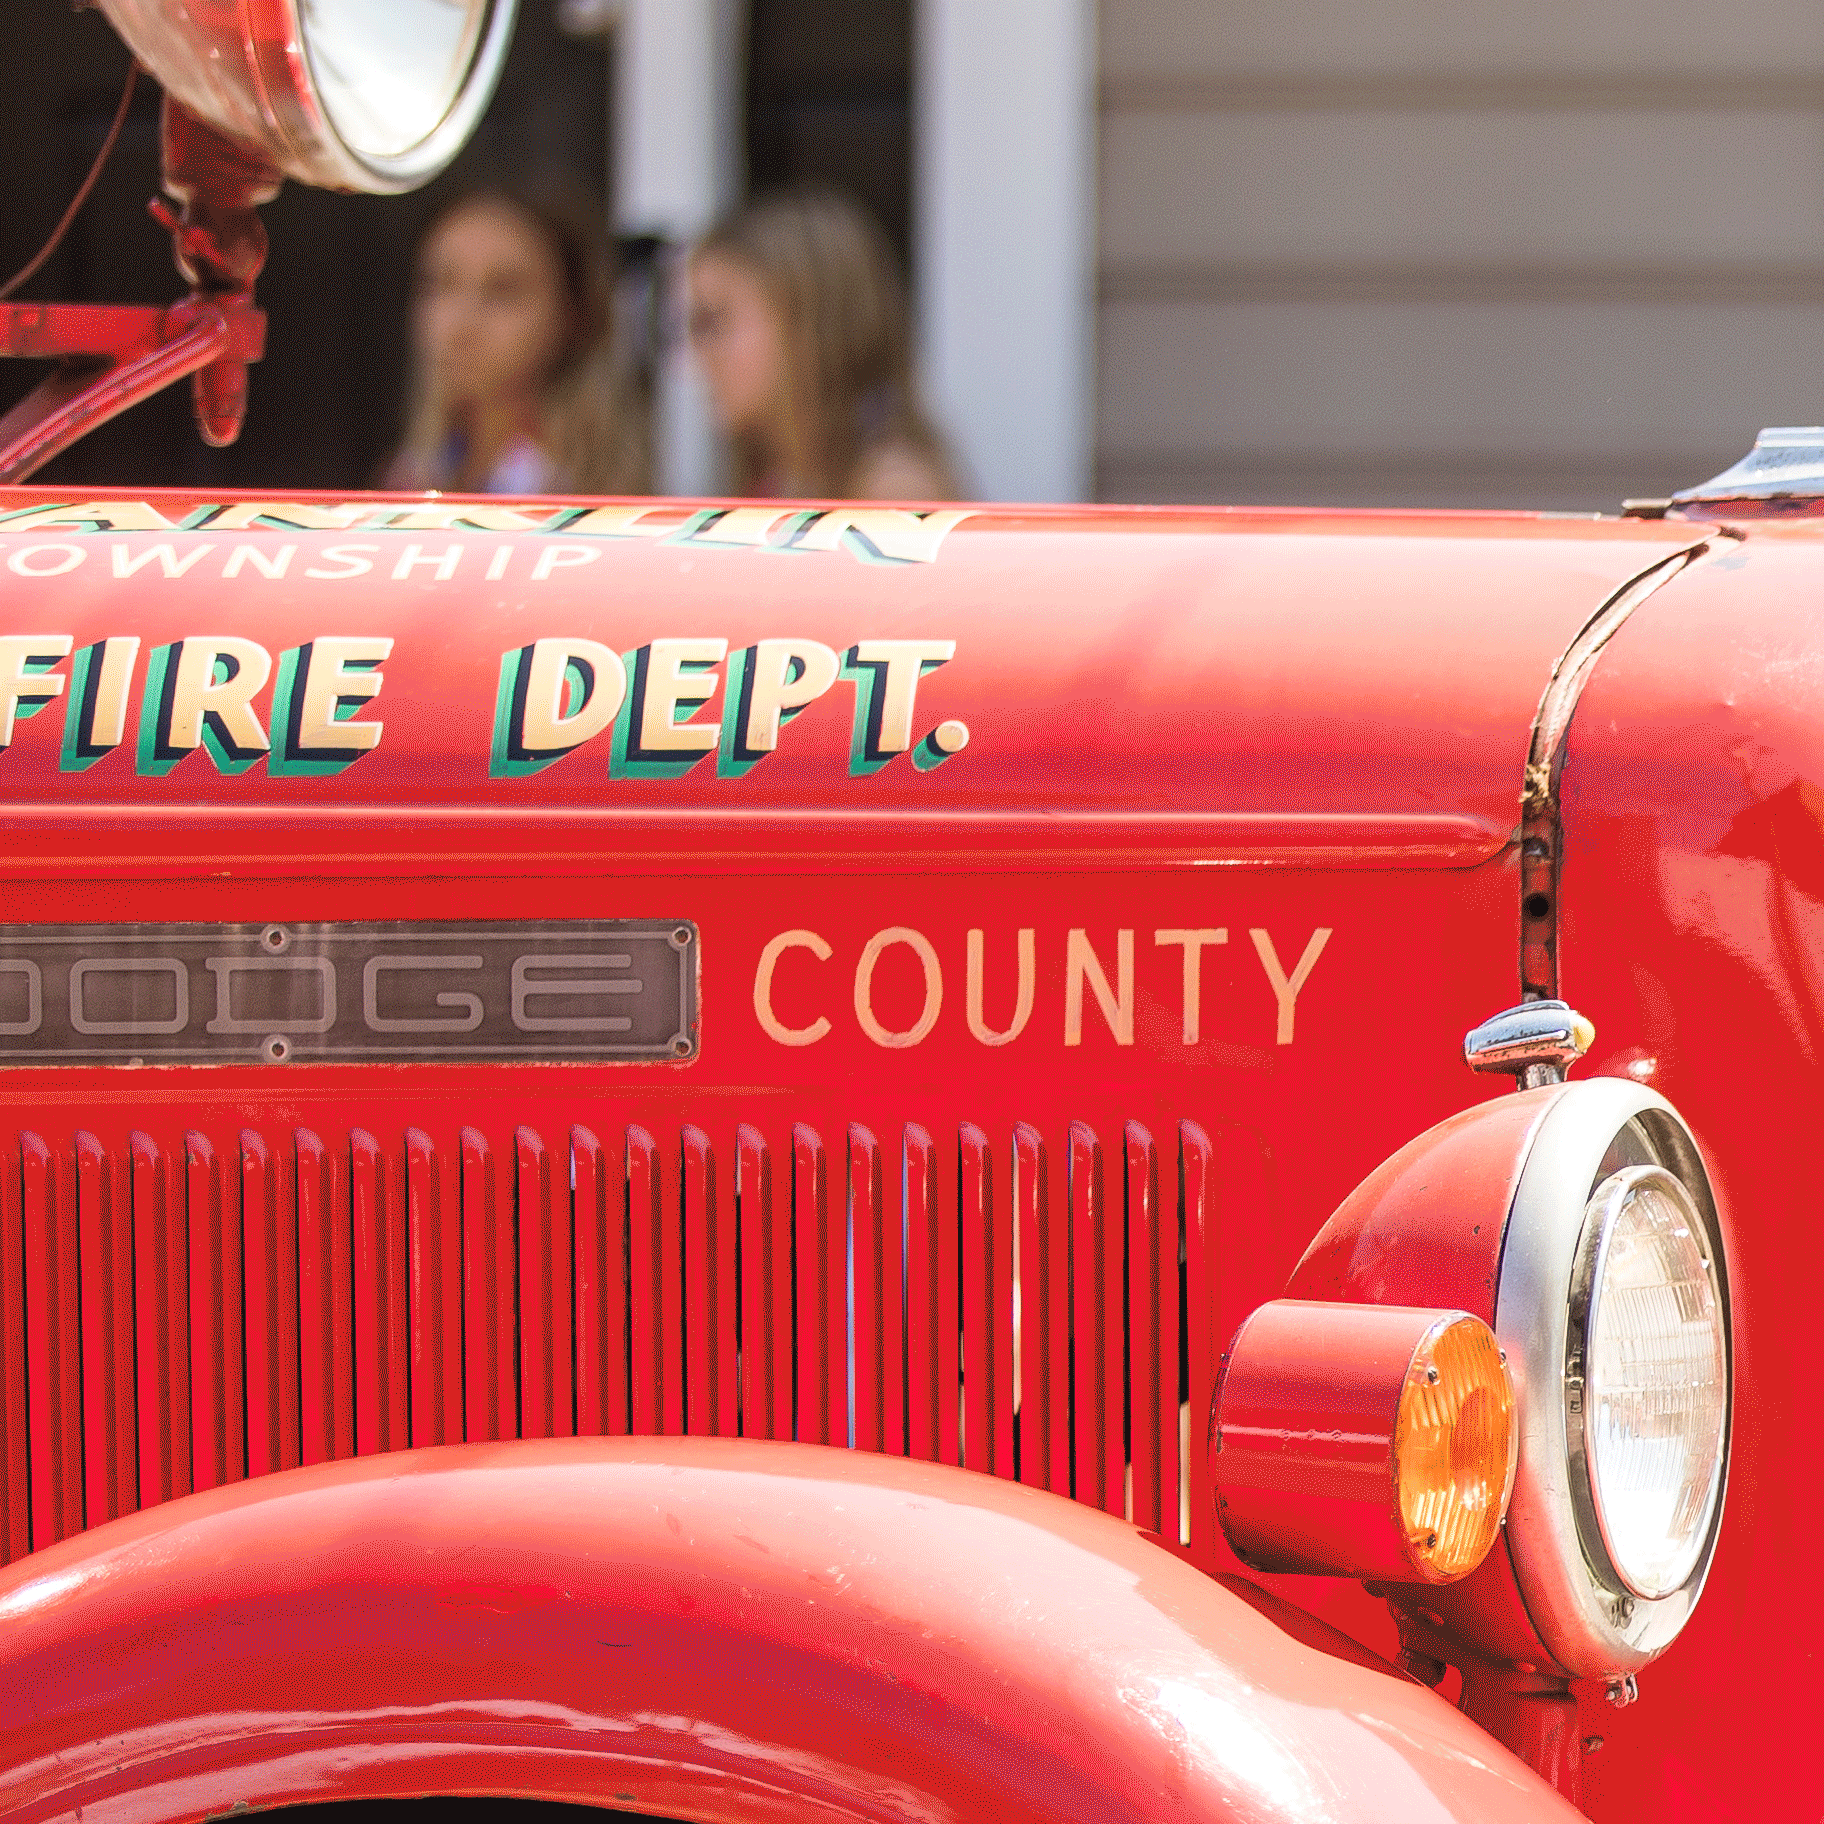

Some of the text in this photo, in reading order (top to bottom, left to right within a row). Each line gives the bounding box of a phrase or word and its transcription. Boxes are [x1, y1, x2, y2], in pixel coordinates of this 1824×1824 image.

[0, 500, 984, 566] ANKLIN
[0, 542, 602, 581] OWNSHIP
[0, 634, 971, 780] FIRE DEPT.
[752, 925, 1333, 1048] COUNTY
